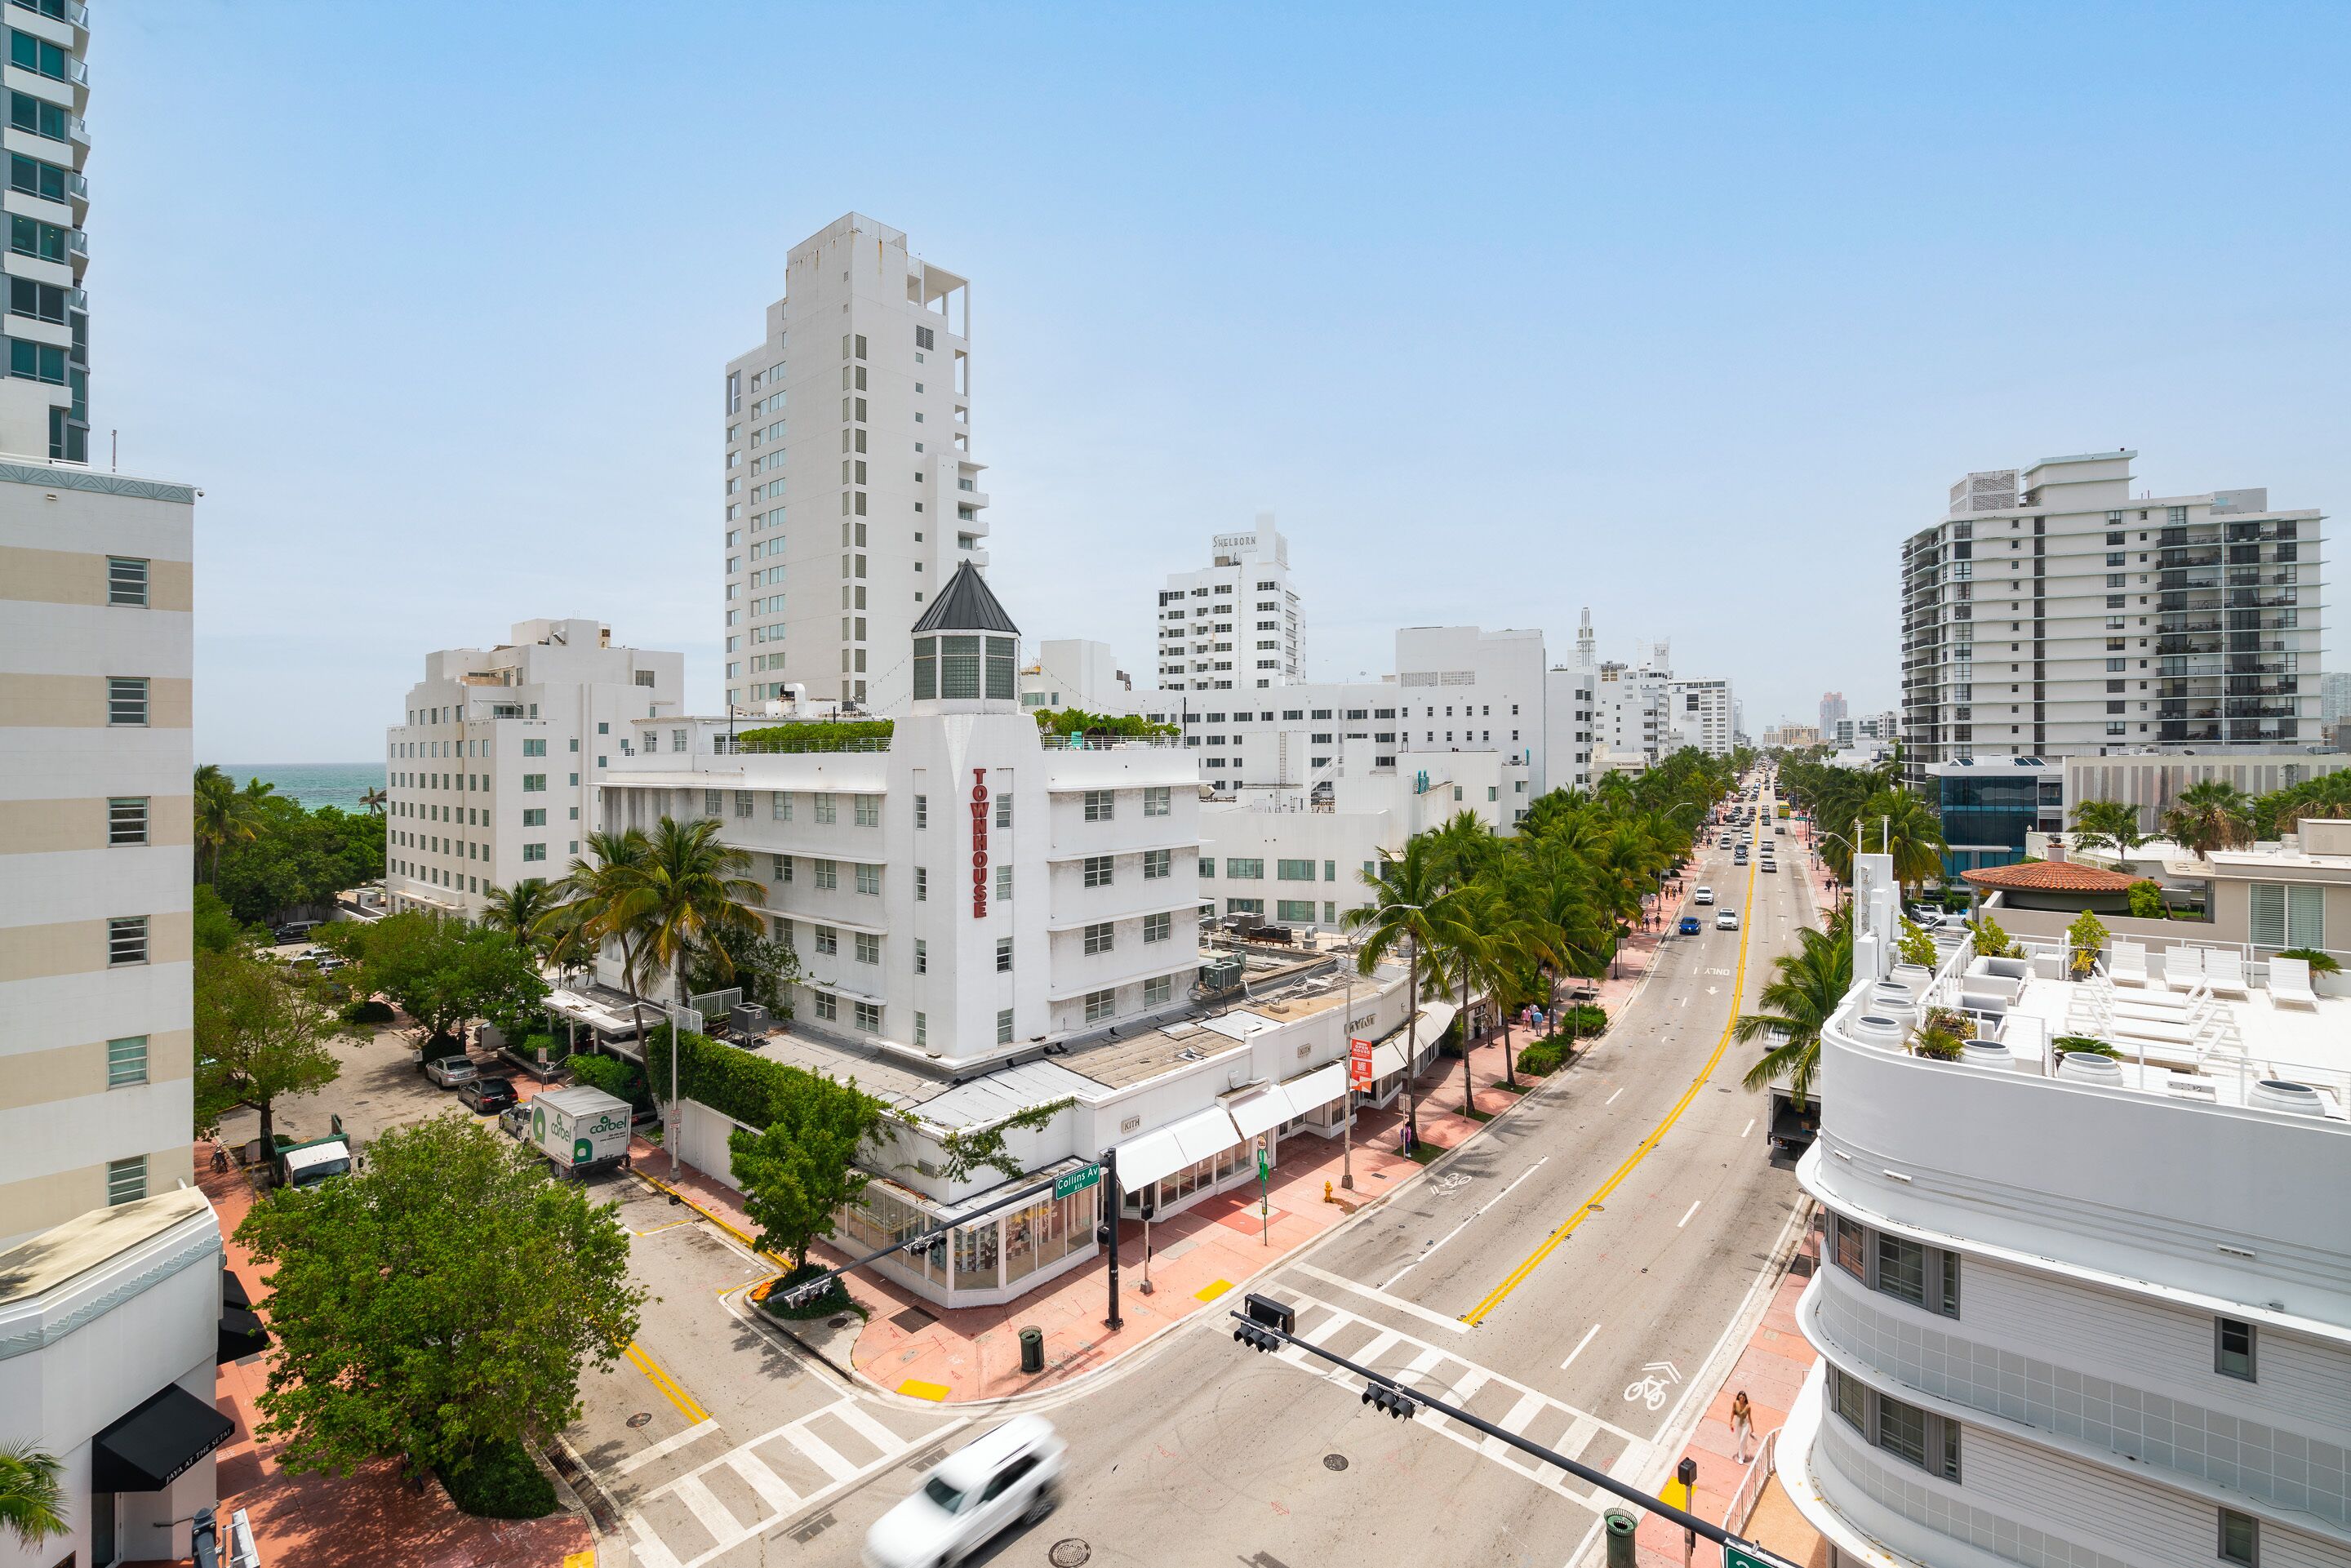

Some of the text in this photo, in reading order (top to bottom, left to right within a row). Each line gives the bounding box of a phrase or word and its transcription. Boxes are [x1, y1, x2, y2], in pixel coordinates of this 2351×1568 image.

[1213, 535, 1255, 548] SHELBORN
[970, 768, 990, 918] TOWNHOUSE
[1704, 967, 1731, 976] ONLY
[1300, 1045, 1311, 1055] KITH
[589, 1116, 627, 1135] carbel
[1124, 1118, 1140, 1131] KITH
[1057, 1167, 1099, 1190] Collins Av
[166, 1428, 231, 1486] JAYA AT THE SETAI
